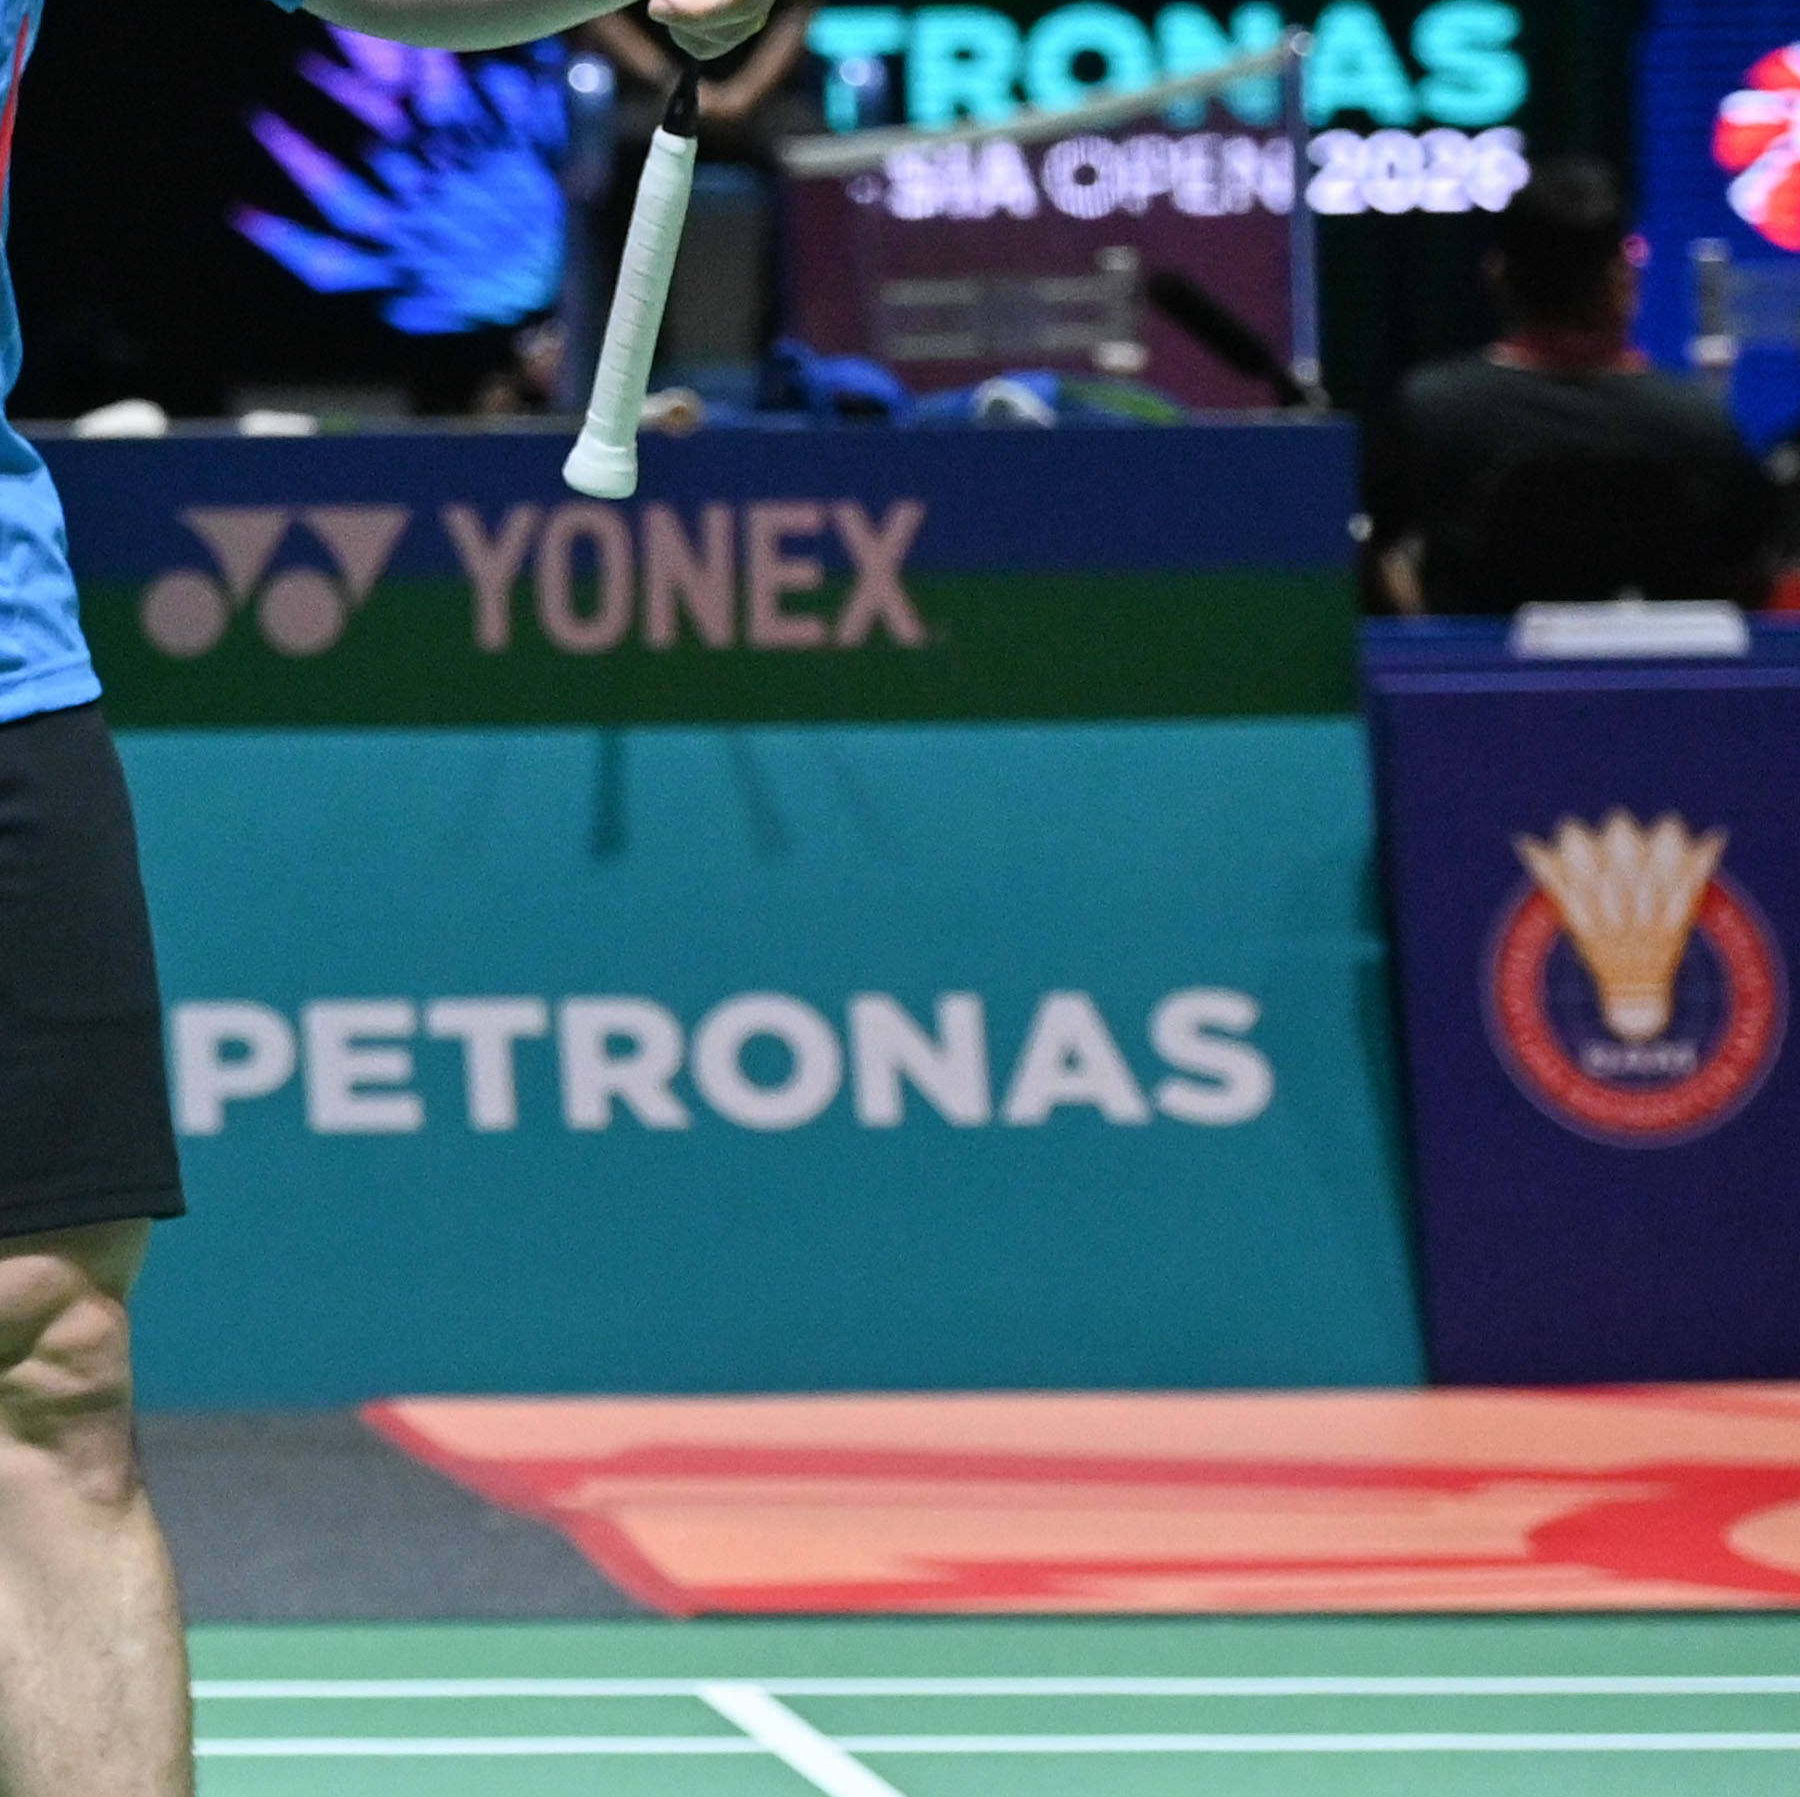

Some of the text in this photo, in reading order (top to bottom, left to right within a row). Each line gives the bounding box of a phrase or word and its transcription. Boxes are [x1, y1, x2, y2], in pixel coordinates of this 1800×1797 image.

[1043, 134, 1296, 220] OPEN
[440, 500, 928, 653] YONEX
[170, 987, 1277, 1136] PETRONAS
